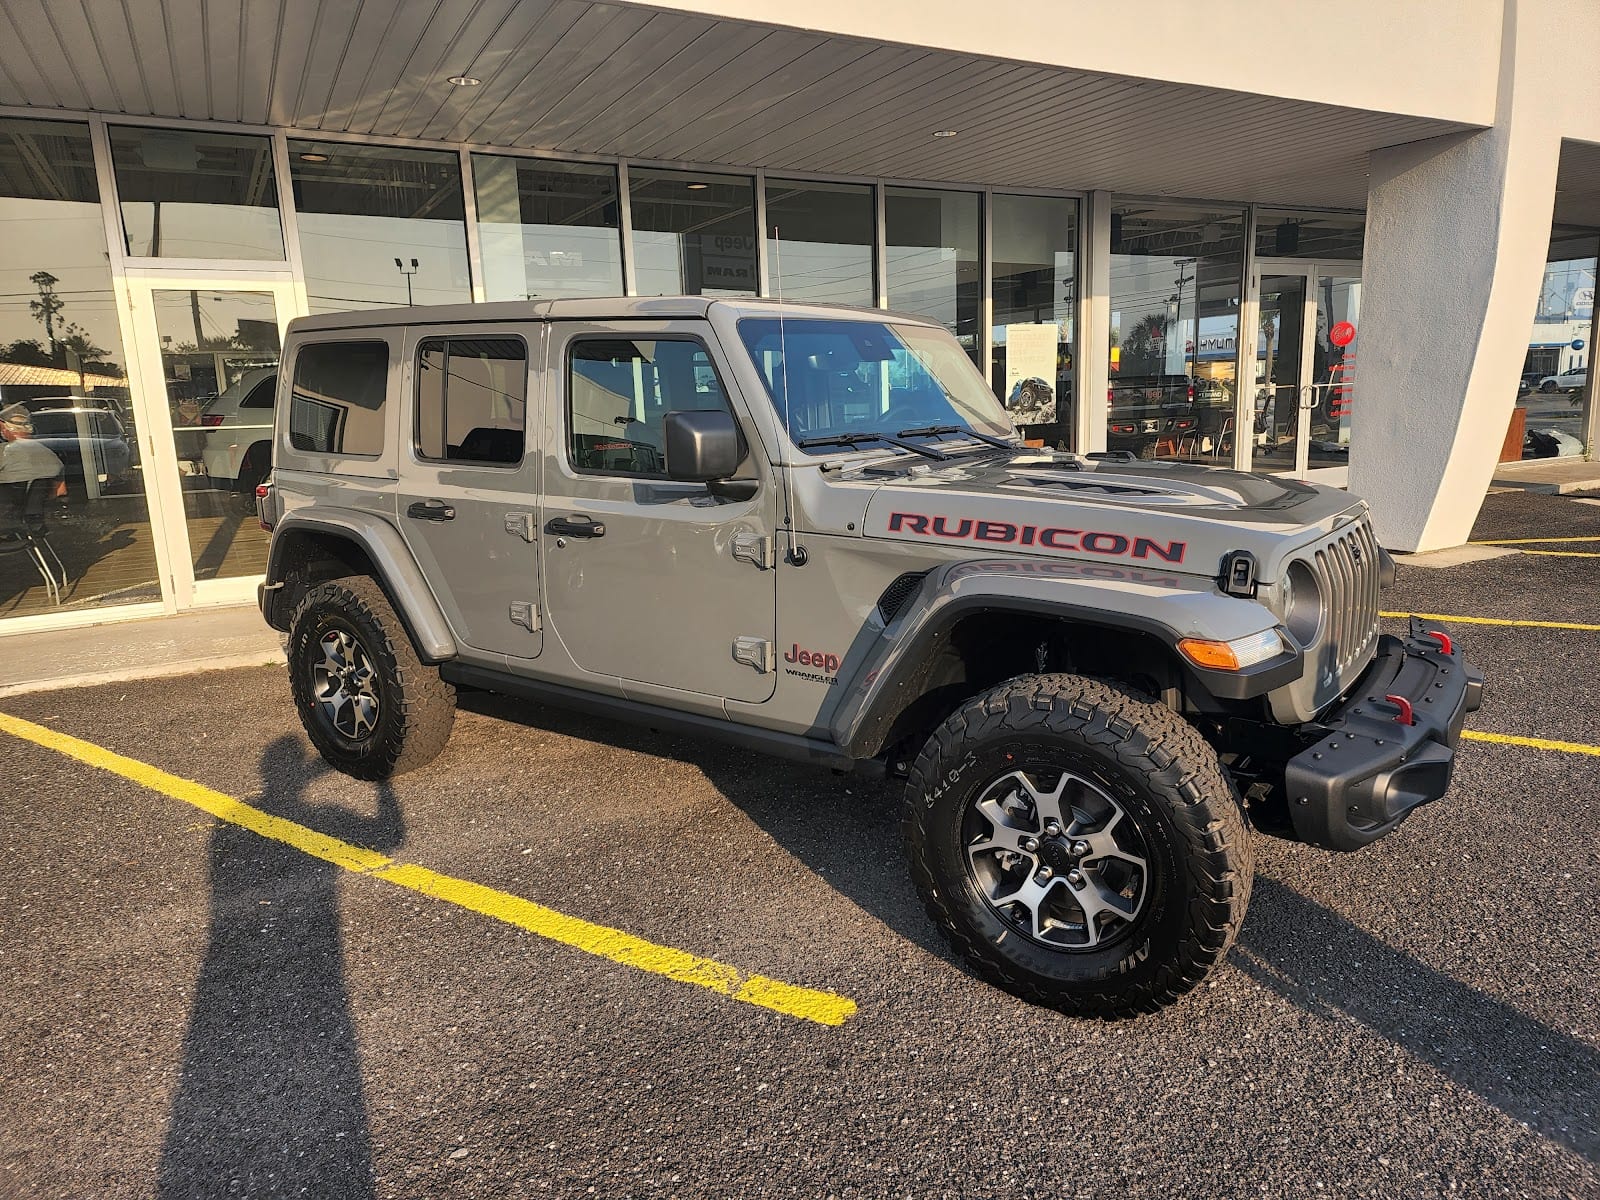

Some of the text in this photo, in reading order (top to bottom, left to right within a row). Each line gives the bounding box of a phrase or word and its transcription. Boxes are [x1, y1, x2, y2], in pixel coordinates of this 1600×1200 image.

[525, 250, 583, 267] AM
[1200, 337, 1234, 350] HYUN
[888, 512, 1187, 564] RUBICON
[784, 642, 841, 673] Jeep
[785, 668, 838, 683] WRANGLER
